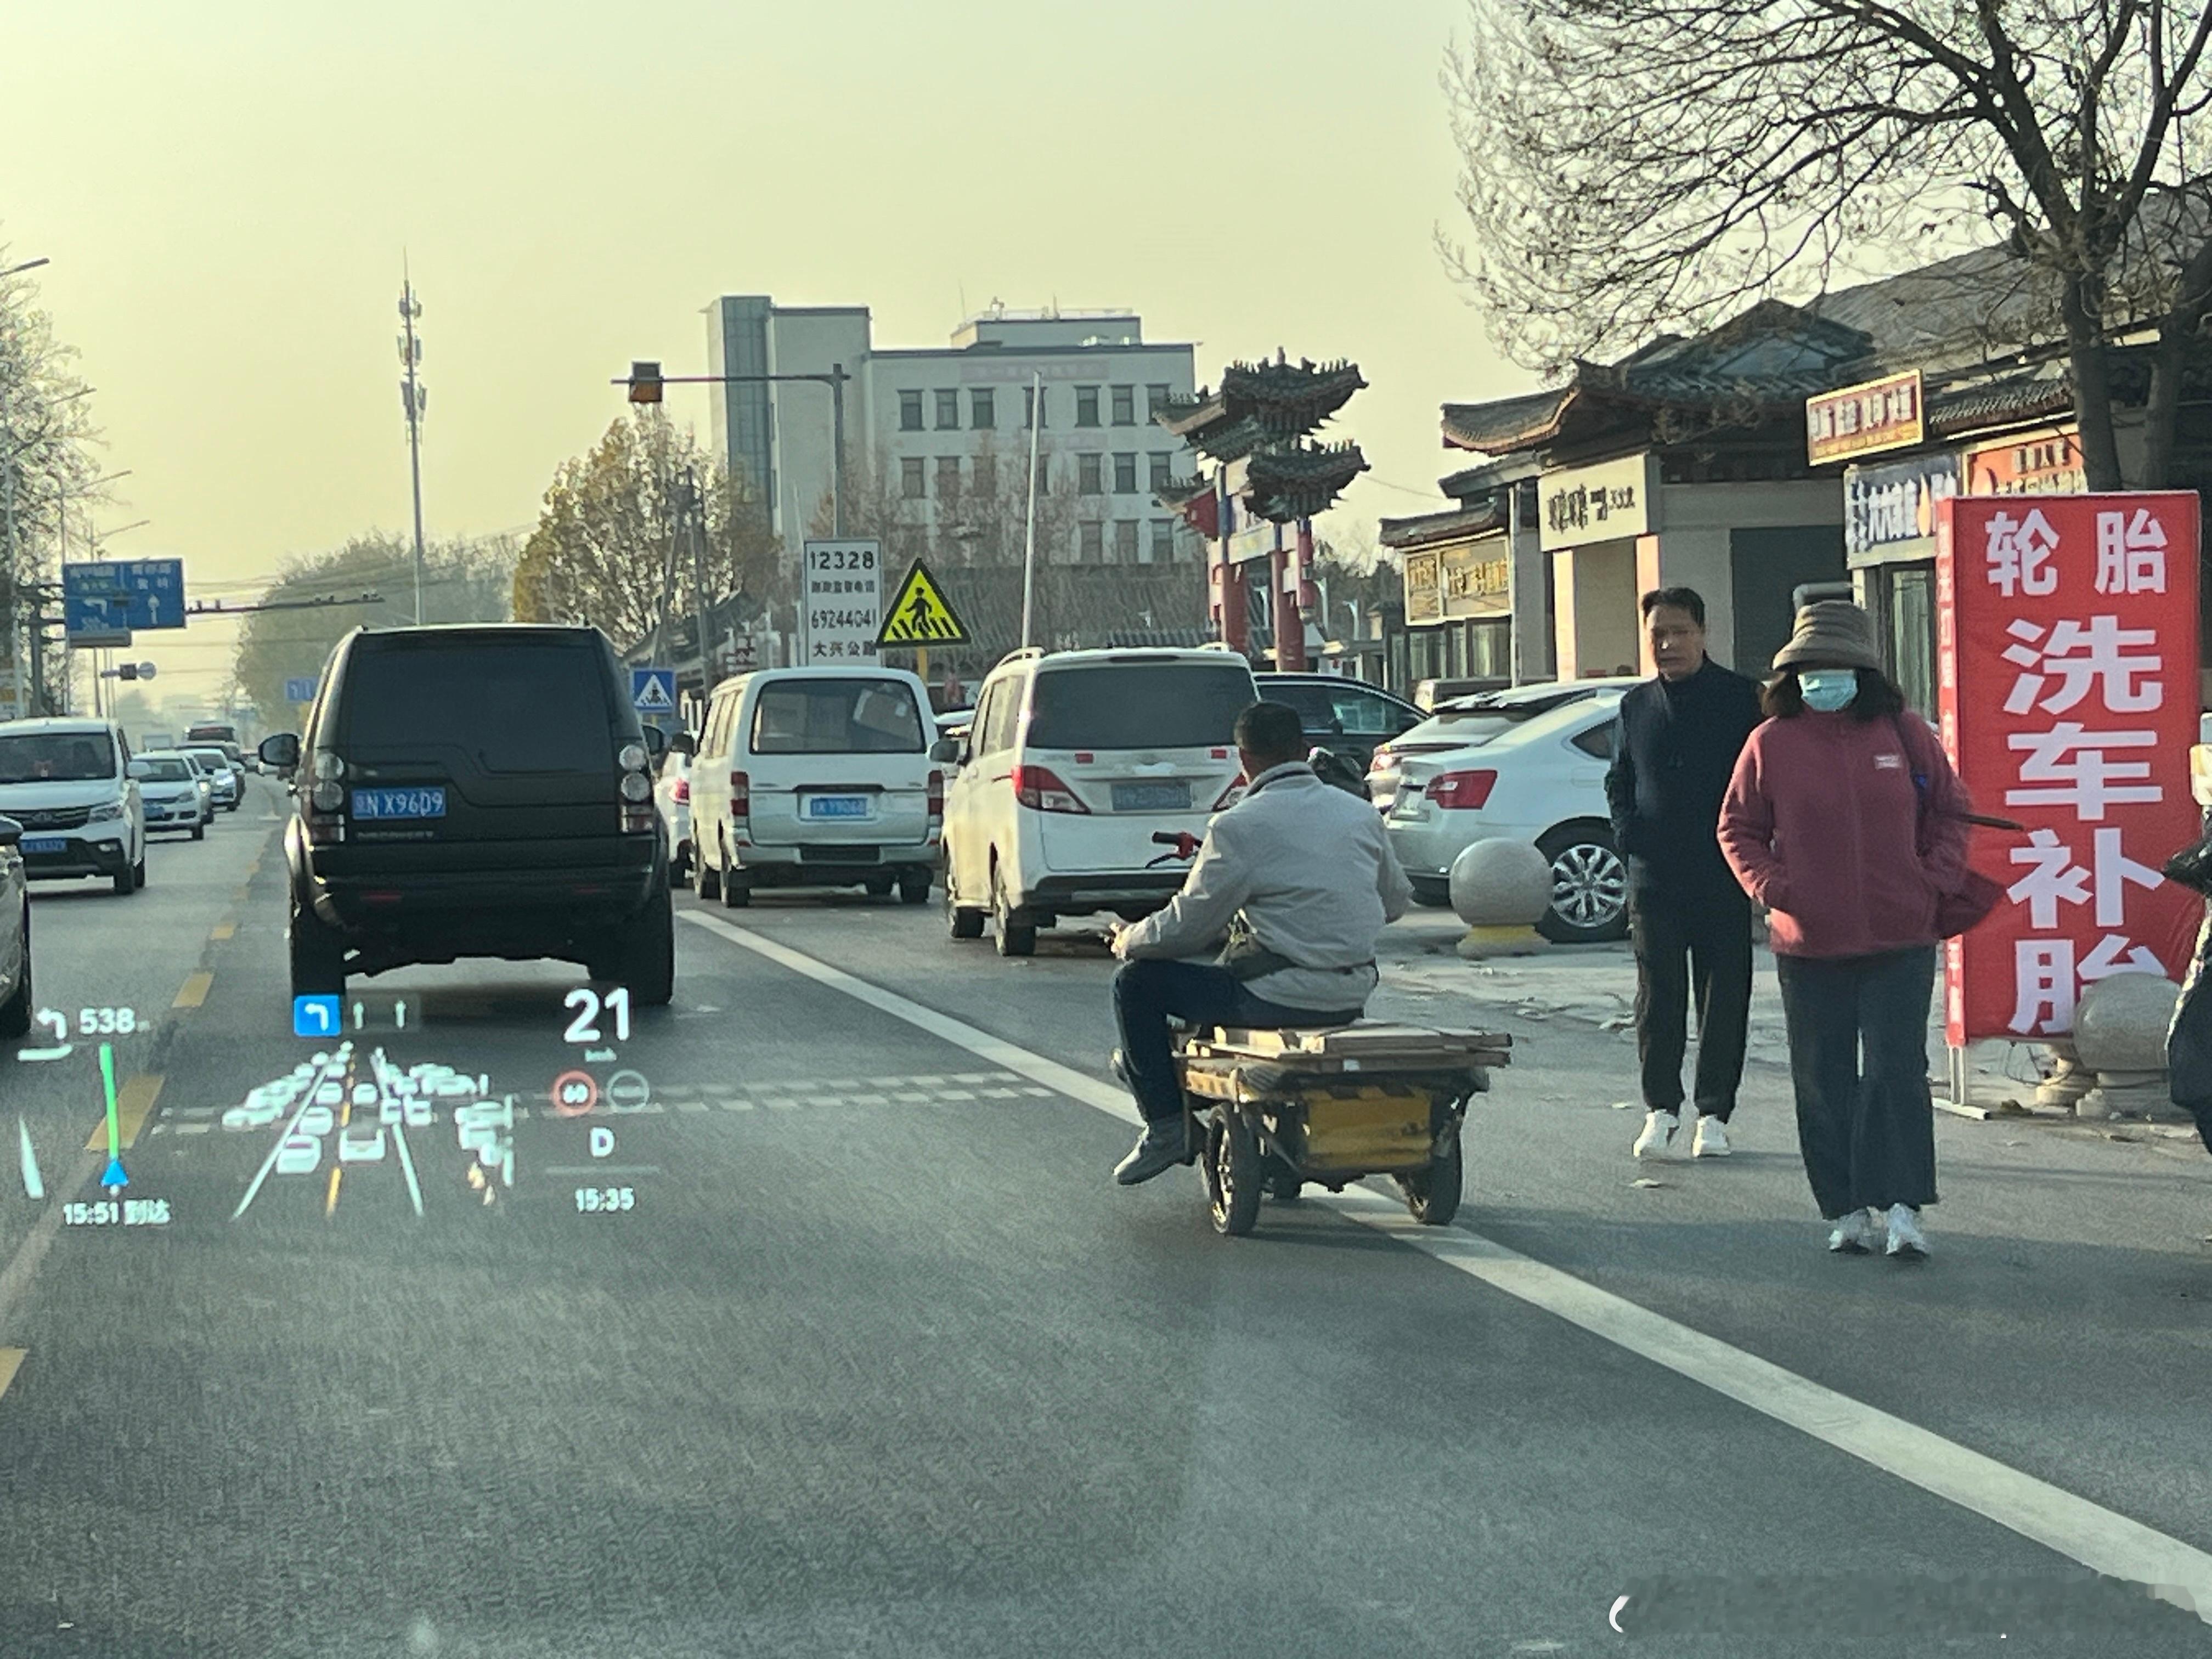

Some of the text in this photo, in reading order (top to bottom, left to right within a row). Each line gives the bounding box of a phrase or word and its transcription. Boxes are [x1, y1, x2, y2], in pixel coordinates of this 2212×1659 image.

[811, 551, 874, 569] 12328
[811, 609, 877, 629] 69244041
[812, 640, 877, 657] 大兴公路
[80, 1007, 135, 1034] 538
[563, 987, 629, 1043] 21
[590, 1127, 614, 1158] D
[575, 1187, 634, 1212] 15:35
[63, 1201, 119, 1224] 15:51
